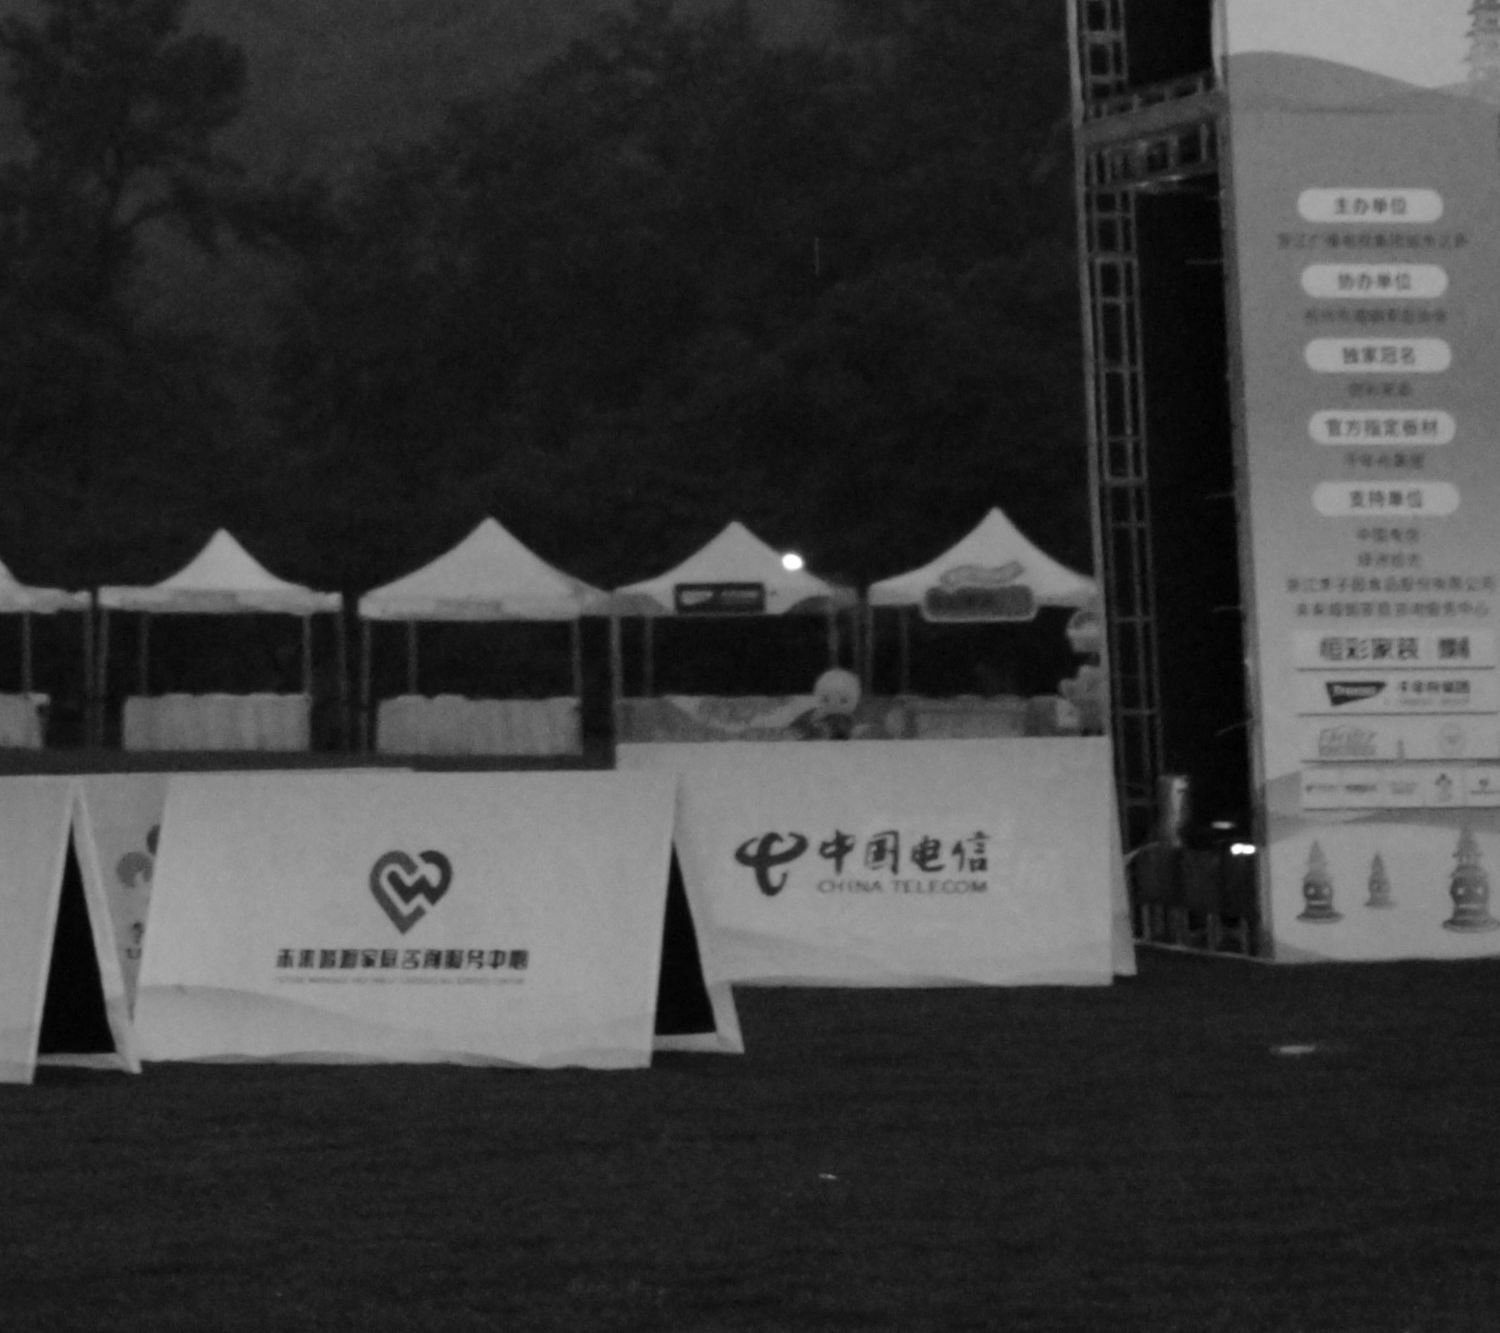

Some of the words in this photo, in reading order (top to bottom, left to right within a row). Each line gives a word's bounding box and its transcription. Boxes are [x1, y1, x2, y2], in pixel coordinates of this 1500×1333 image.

[1333, 196, 1409, 218] 主办单位
[1341, 345, 1416, 366] 独家冠名
[1348, 489, 1424, 510] 支持单位
[817, 828, 991, 876] 中国电信
[817, 878, 882, 894] CHINA
[892, 878, 989, 894] TELECOM
